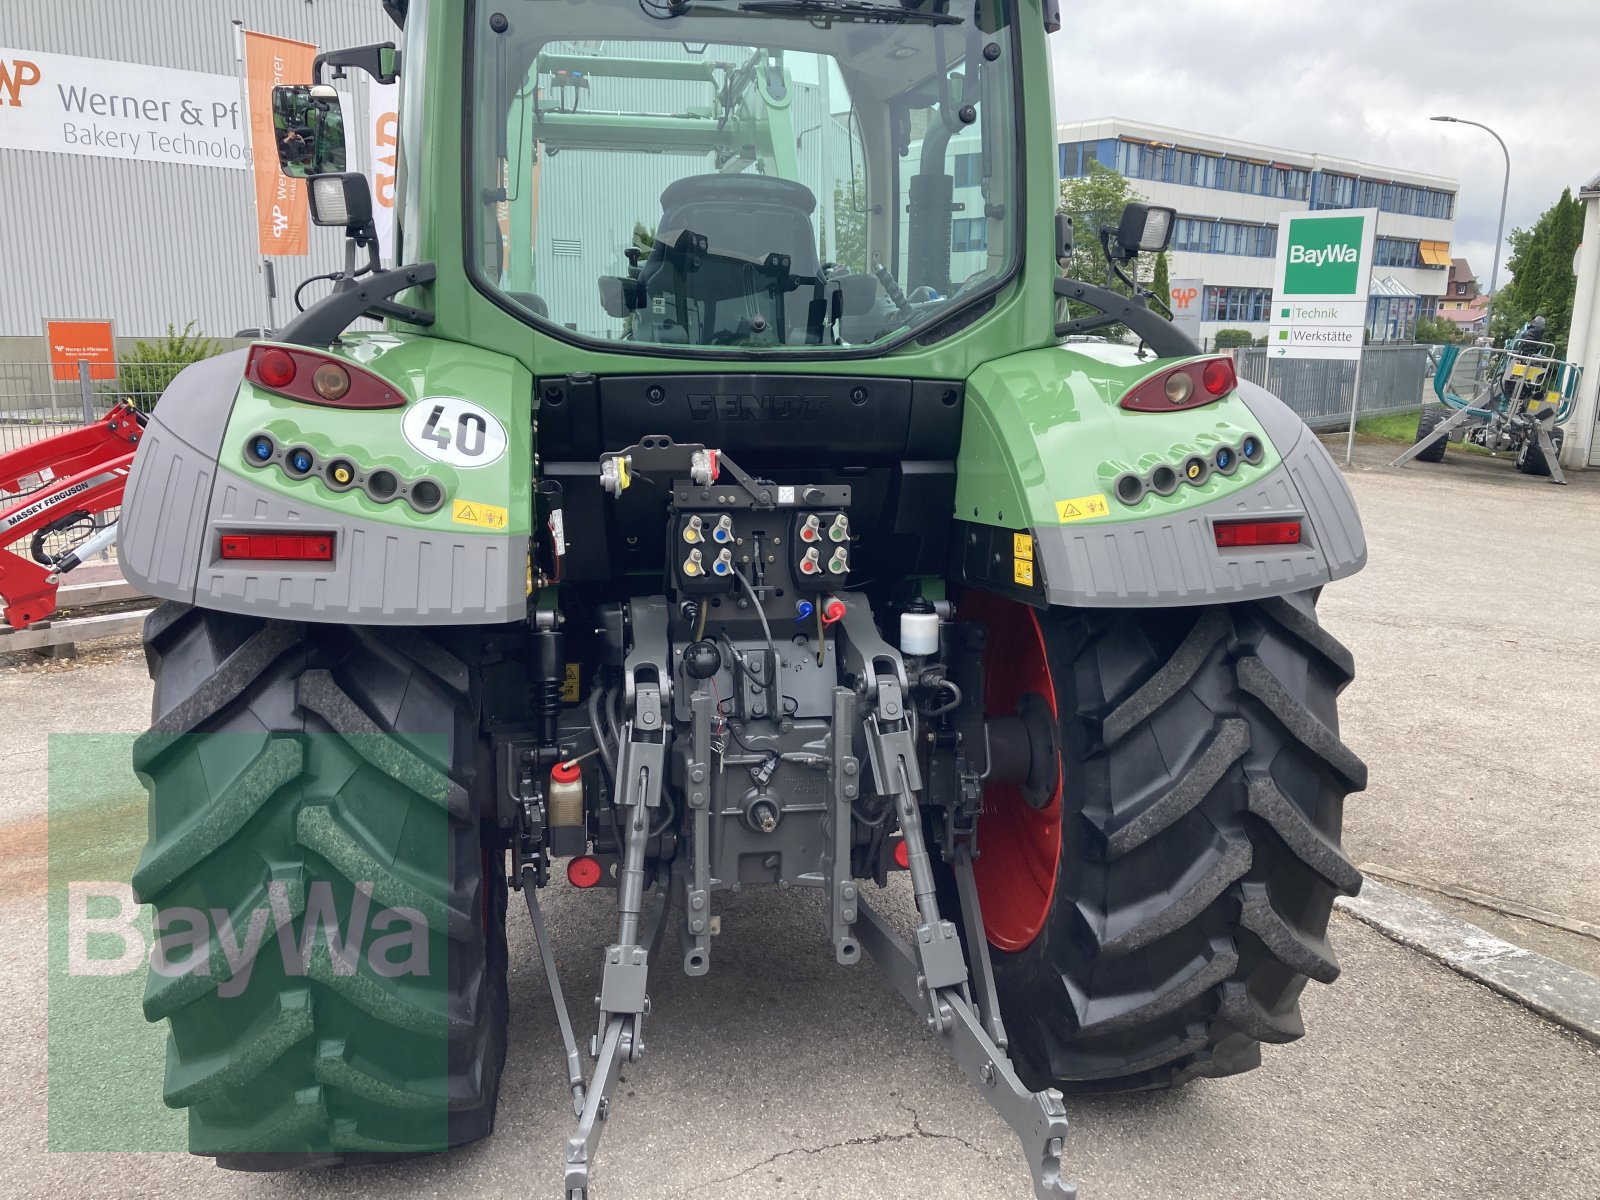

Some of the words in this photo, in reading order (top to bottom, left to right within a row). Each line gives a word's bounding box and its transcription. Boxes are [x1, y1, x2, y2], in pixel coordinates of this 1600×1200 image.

[57, 84, 170, 122] Werner
[180, 99, 204, 125] &
[63, 122, 140, 155] Bakery
[1290, 244, 1357, 266] BayWa
[1295, 308, 1338, 319] Technik
[1293, 331, 1352, 342] Werkstätte
[687, 394, 831, 421] FENDT
[421, 404, 487, 457] 40
[7, 503, 43, 526] MASSEY
[44, 482, 89, 507] FERGUSON
